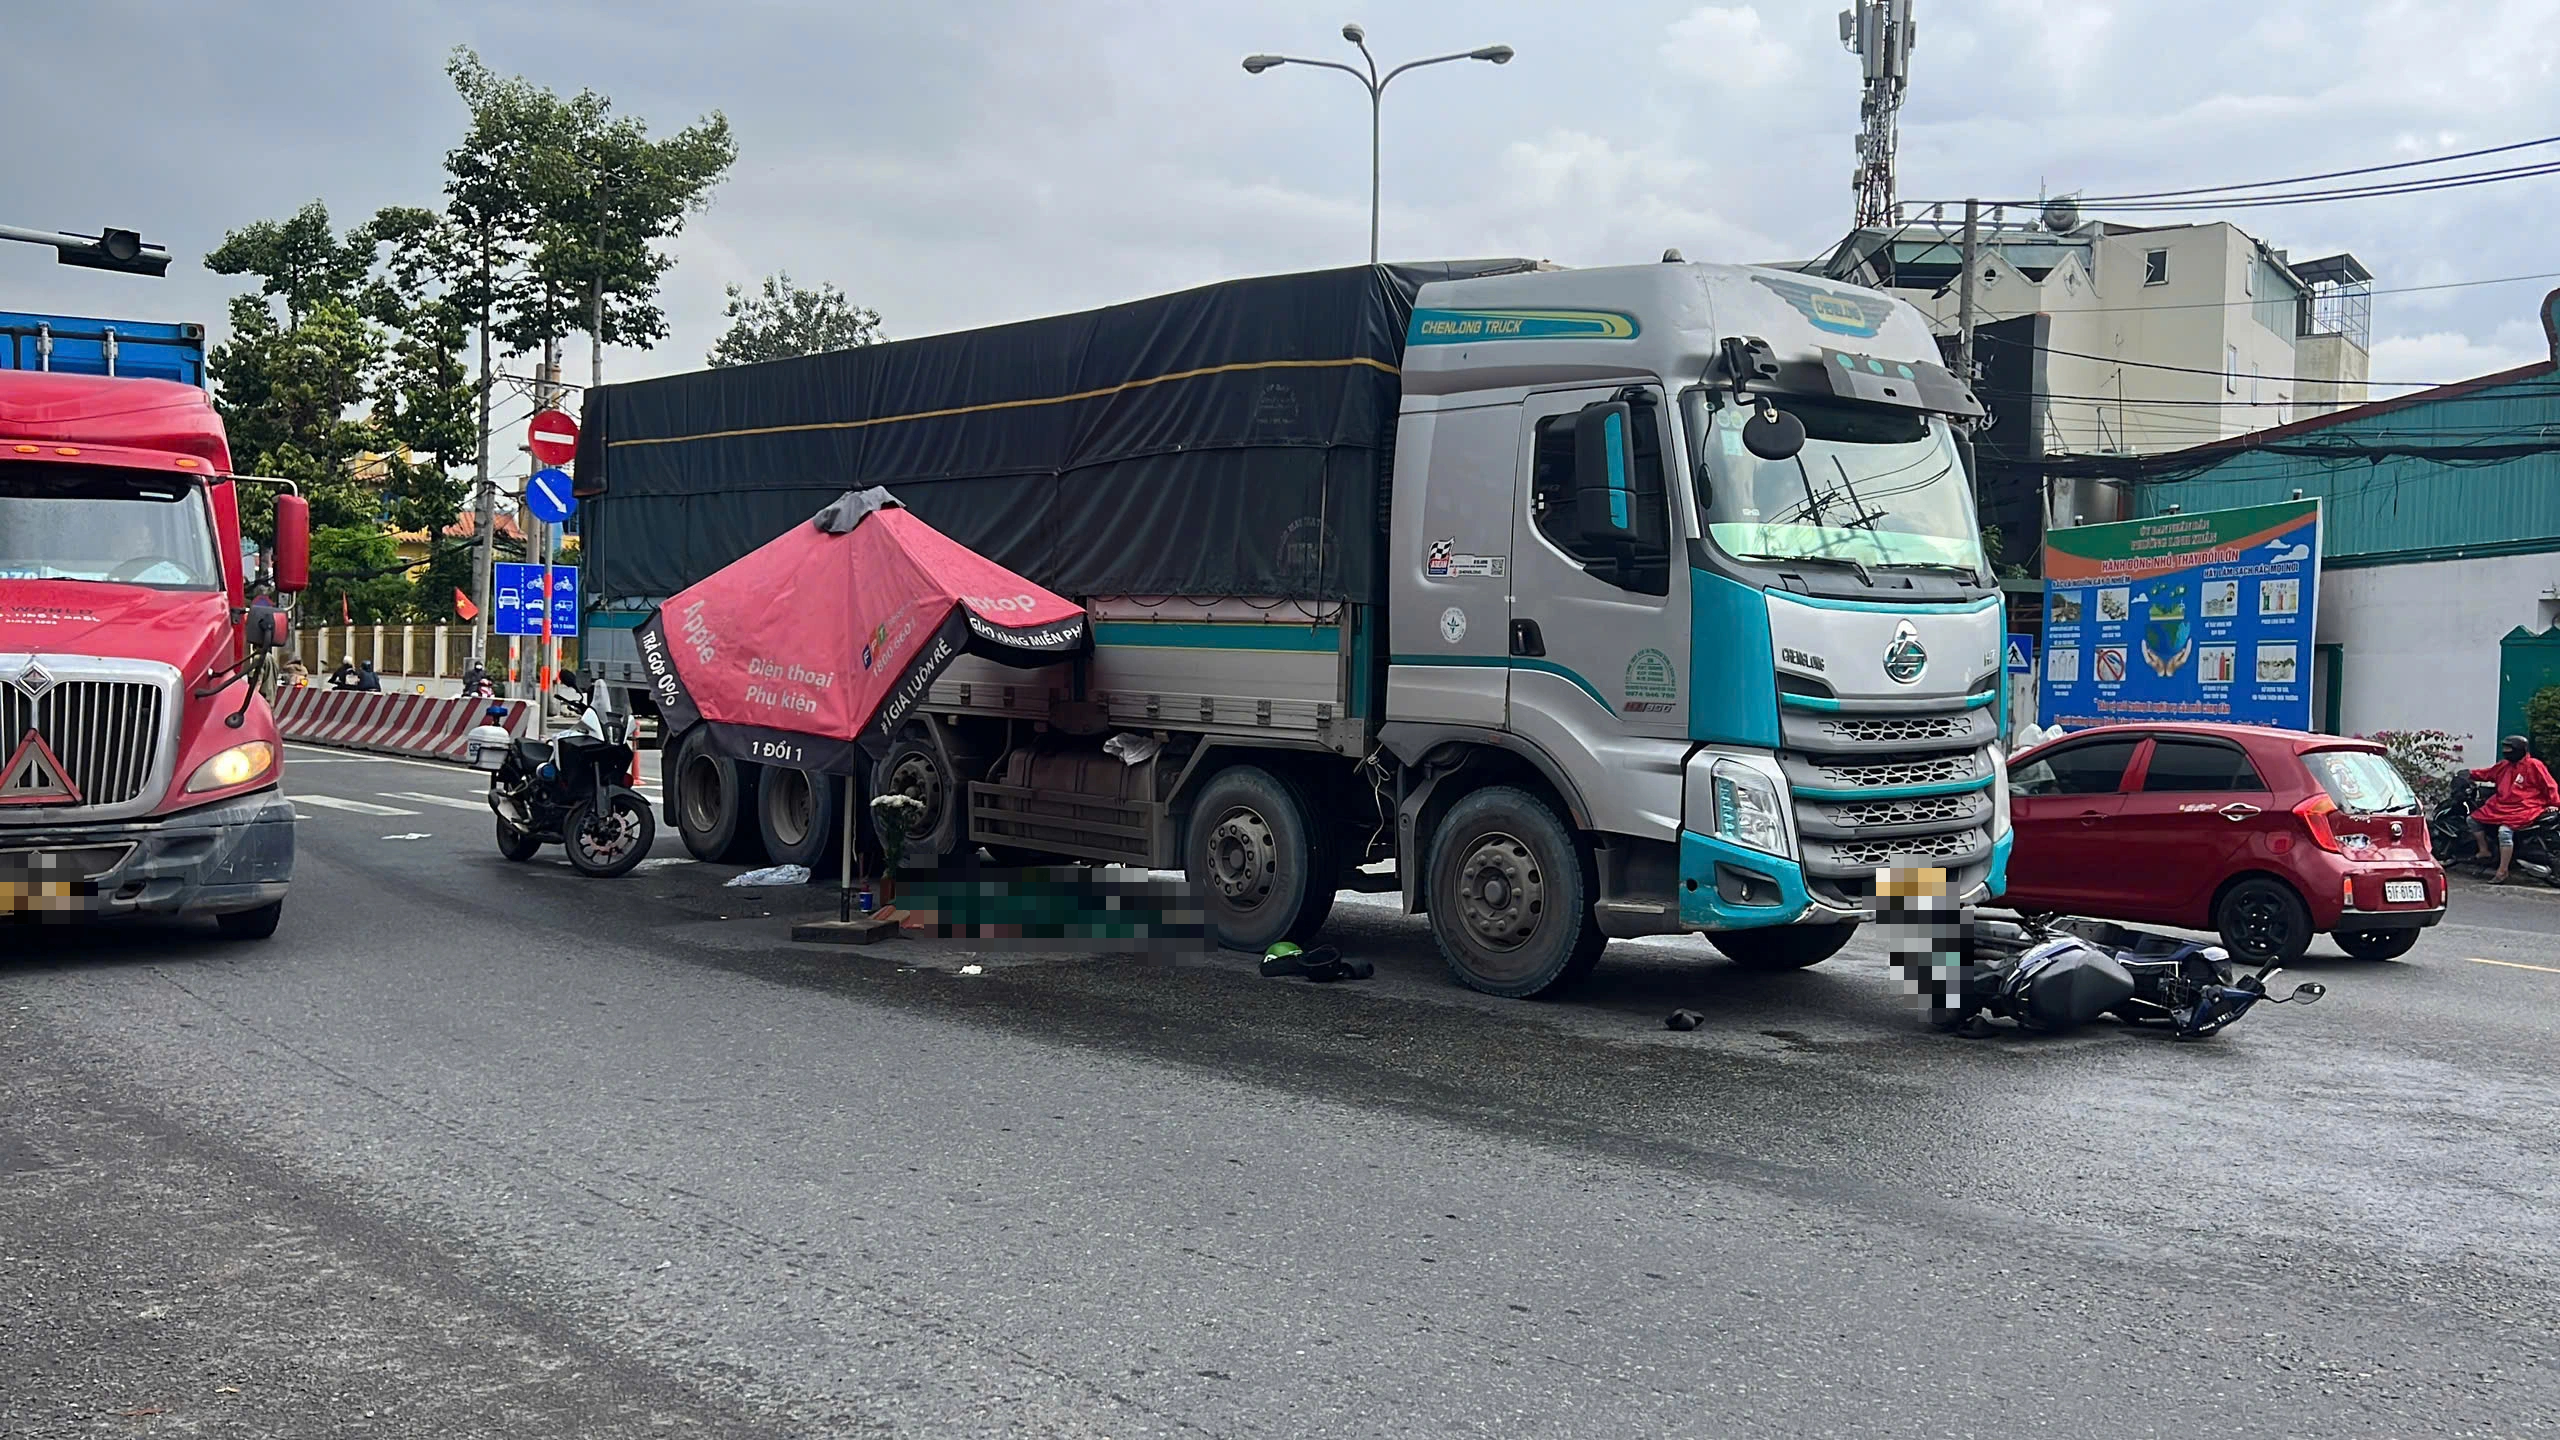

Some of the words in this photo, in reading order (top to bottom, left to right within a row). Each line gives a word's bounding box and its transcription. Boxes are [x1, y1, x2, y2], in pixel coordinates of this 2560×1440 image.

[1421, 320, 1482, 335] CHENLONG
[1485, 320, 1524, 334] TRUCK
[642, 630, 661, 654] TRẢ
[683, 599, 717, 665] Apple
[1029, 630, 1064, 647] MIỄN
[647, 651, 665, 676] GÓP
[748, 658, 784, 681] Điện
[787, 664, 834, 691] thoại
[873, 646, 894, 677] 1800
[907, 657, 935, 698] LUÔN
[933, 637, 953, 664] RẺ
[658, 674, 680, 706] 0%
[745, 685, 777, 711] Phụ
[781, 690, 817, 716] kiện
[752, 741, 759, 755] 1
[763, 740, 791, 760] ĐỔI
[795, 748, 802, 762] 1
